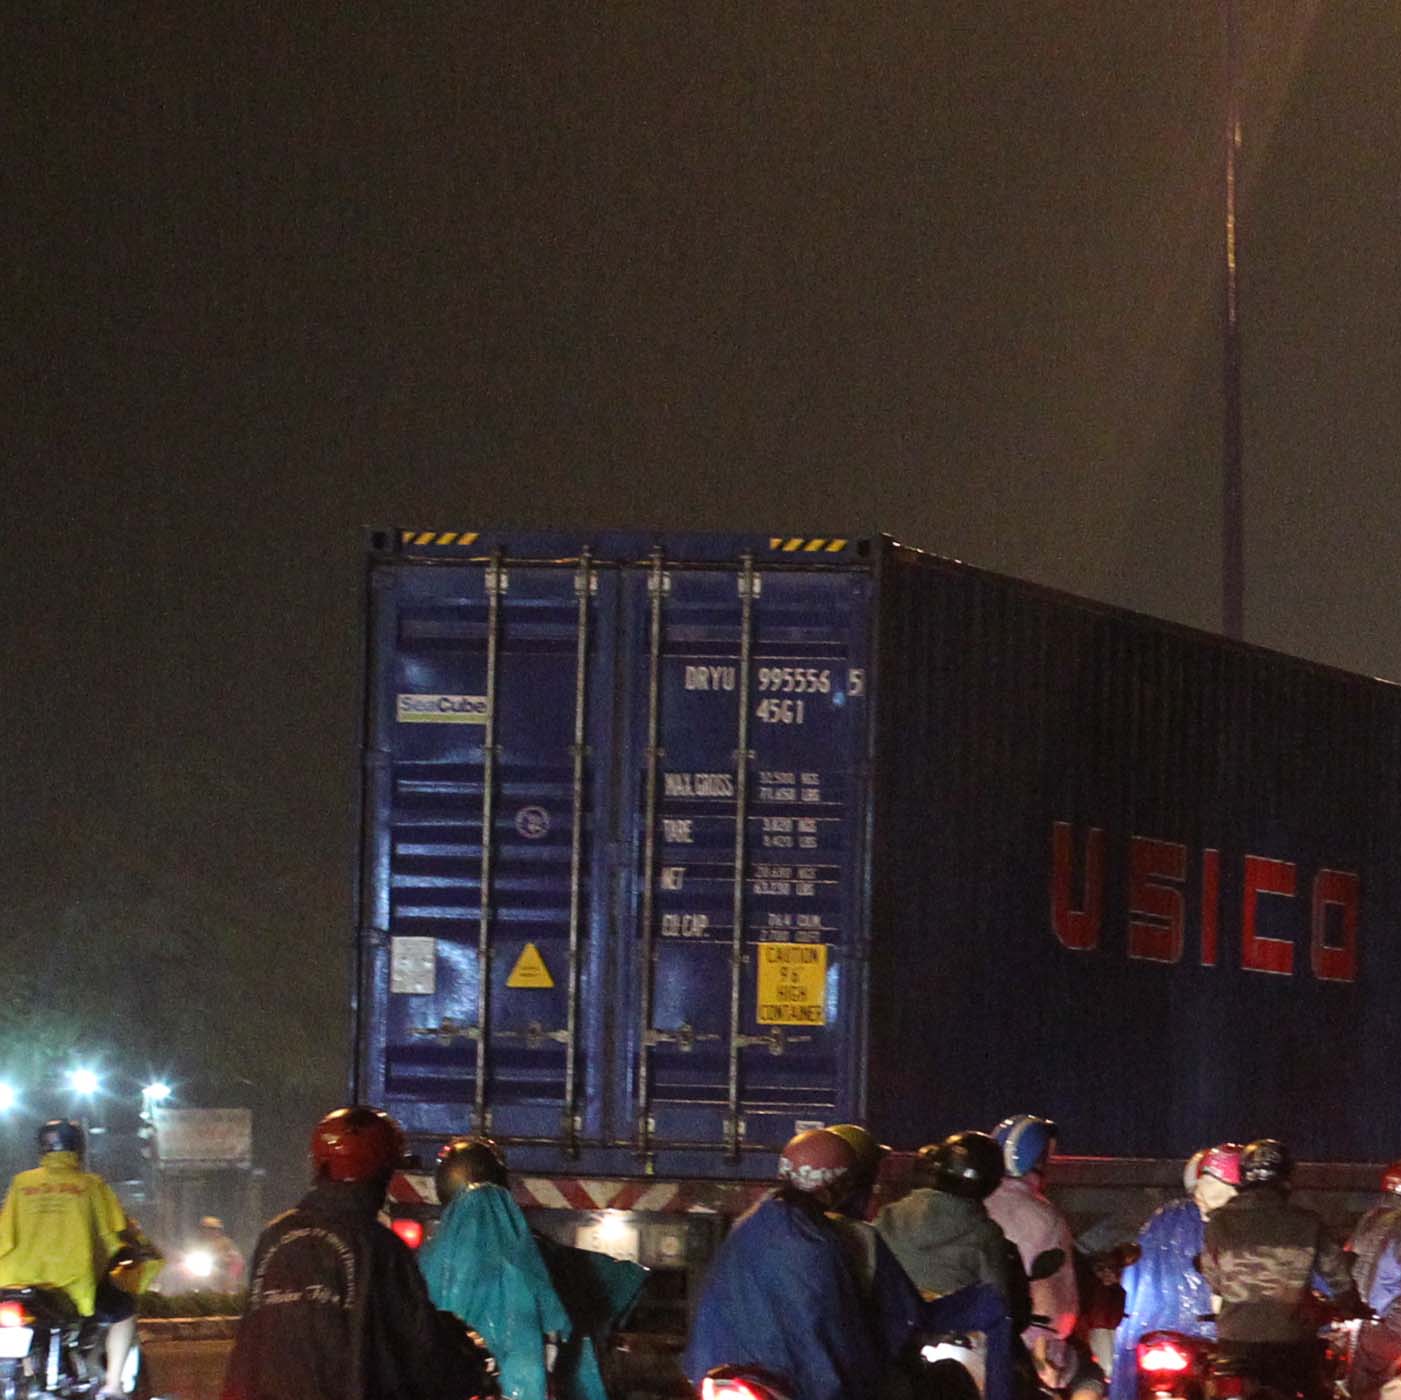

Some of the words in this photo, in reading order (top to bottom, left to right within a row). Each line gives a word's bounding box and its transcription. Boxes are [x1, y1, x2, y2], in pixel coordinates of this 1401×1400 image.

[684, 666, 736, 691] DRYU
[758, 668, 831, 693] 995556
[848, 669, 864, 696] 5
[401, 697, 487, 714] SeaCube
[1051, 821, 1357, 983] USICO
[766, 947, 818, 963] CAUTION
[776, 985, 807, 1002] HIGH
[761, 1004, 822, 1022] CONTAINER
